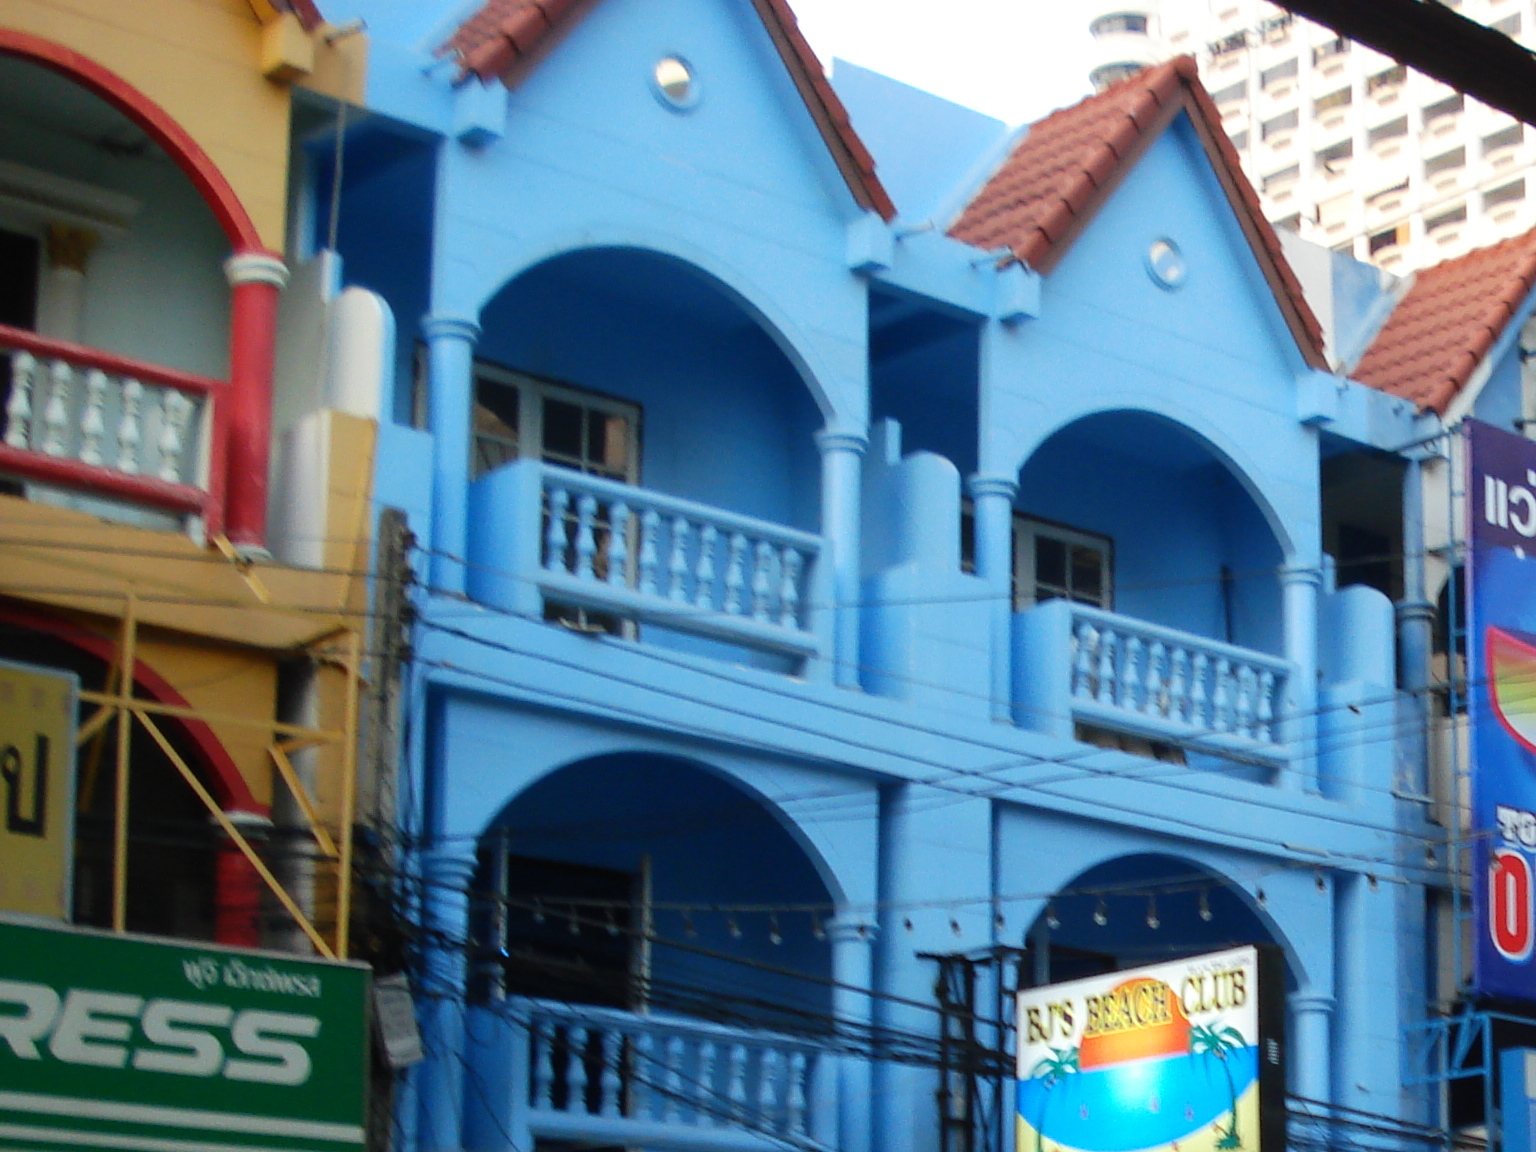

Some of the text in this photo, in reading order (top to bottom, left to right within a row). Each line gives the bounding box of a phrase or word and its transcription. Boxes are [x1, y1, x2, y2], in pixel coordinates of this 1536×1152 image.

[0, 978, 322, 1087] RESS
[1083, 980, 1173, 1039] BEACH
[1179, 967, 1247, 1020] CLUB
